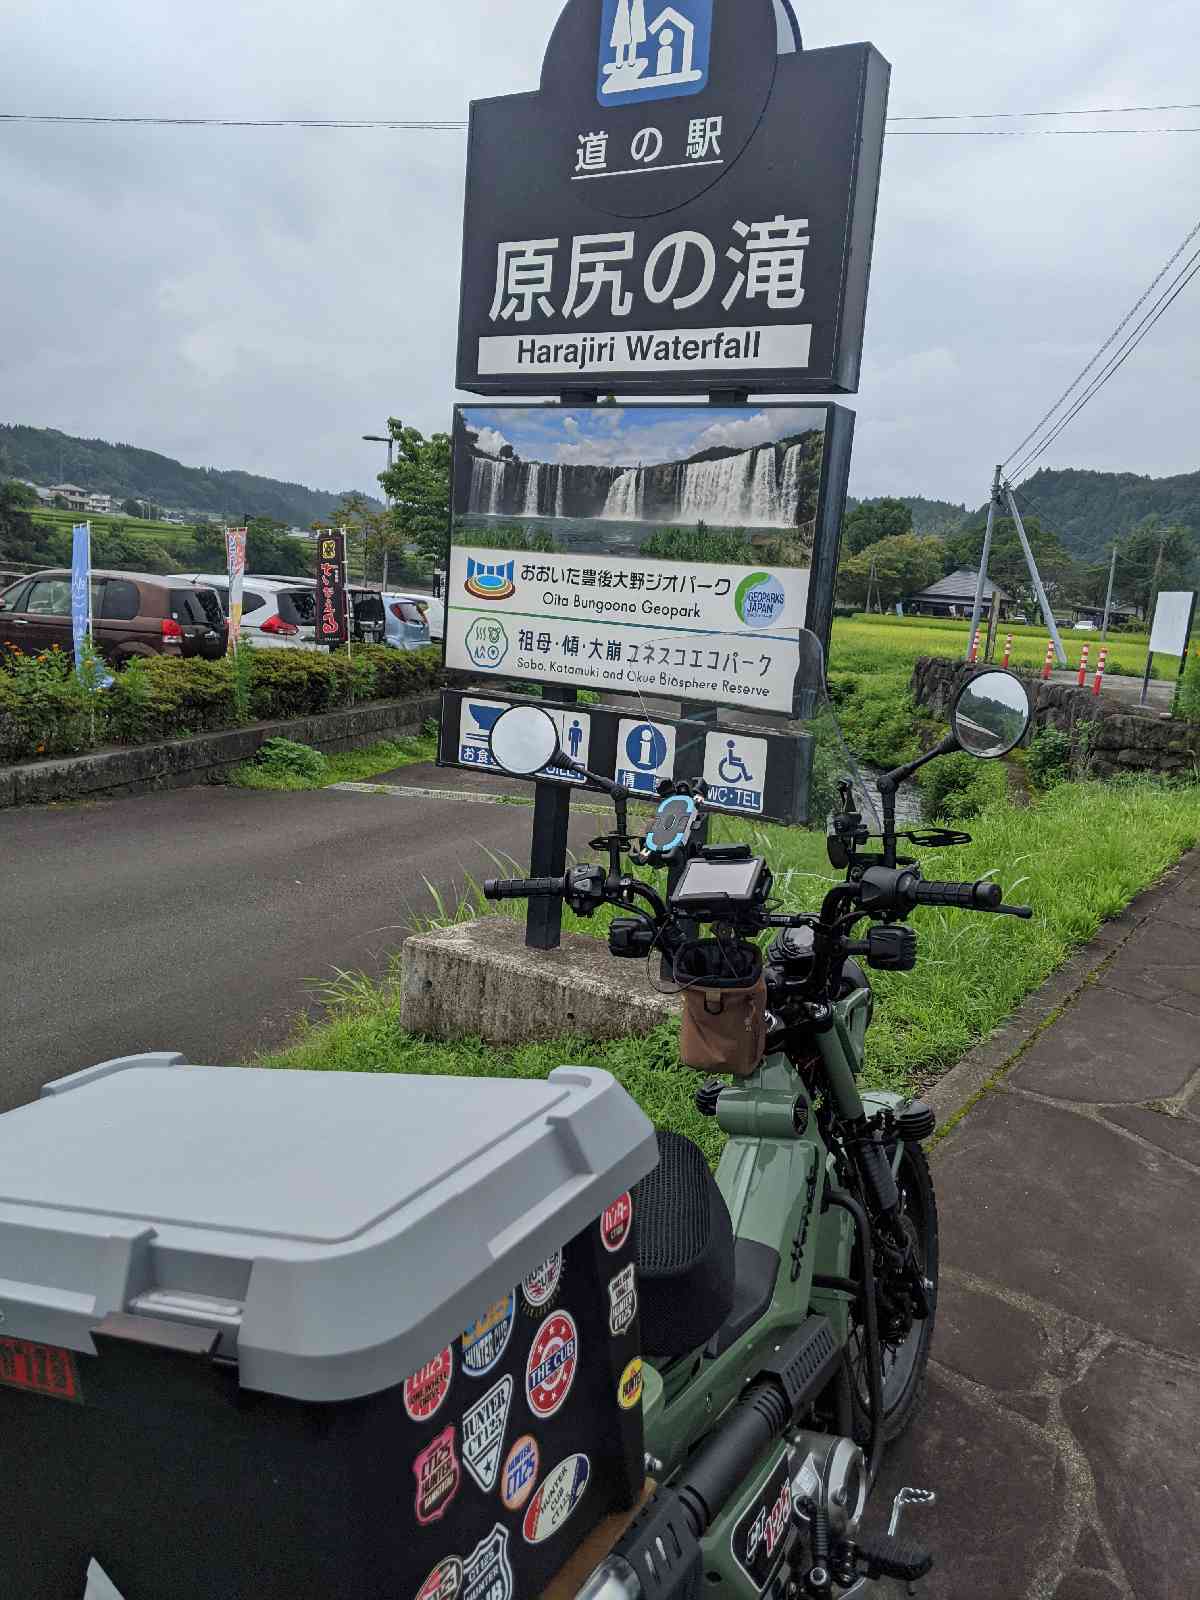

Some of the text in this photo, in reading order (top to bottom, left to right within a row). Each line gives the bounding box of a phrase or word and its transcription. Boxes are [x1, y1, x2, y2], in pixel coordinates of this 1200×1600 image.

[575, 115, 723, 172] 道の駅
[488, 214, 810, 322] 原尻の滝
[517, 331, 761, 370] Harajiri Waterfall
[520, 564, 731, 596] おおいた豊後大野ジオパーク
[749, 591, 784, 604] GEOPARKS
[542, 591, 701, 620] Oita Bungoono Geopark
[747, 602, 773, 614] JAPAN
[550, 660, 600, 678] Katamuki
[602, 669, 623, 680] and
[659, 671, 718, 692] Biosphere
[722, 679, 770, 697] Reserve
[529, 1341, 576, 1389] THE CUB
[541, 1465, 569, 1514] HUNTER
[550, 1486, 565, 1511] CUB
